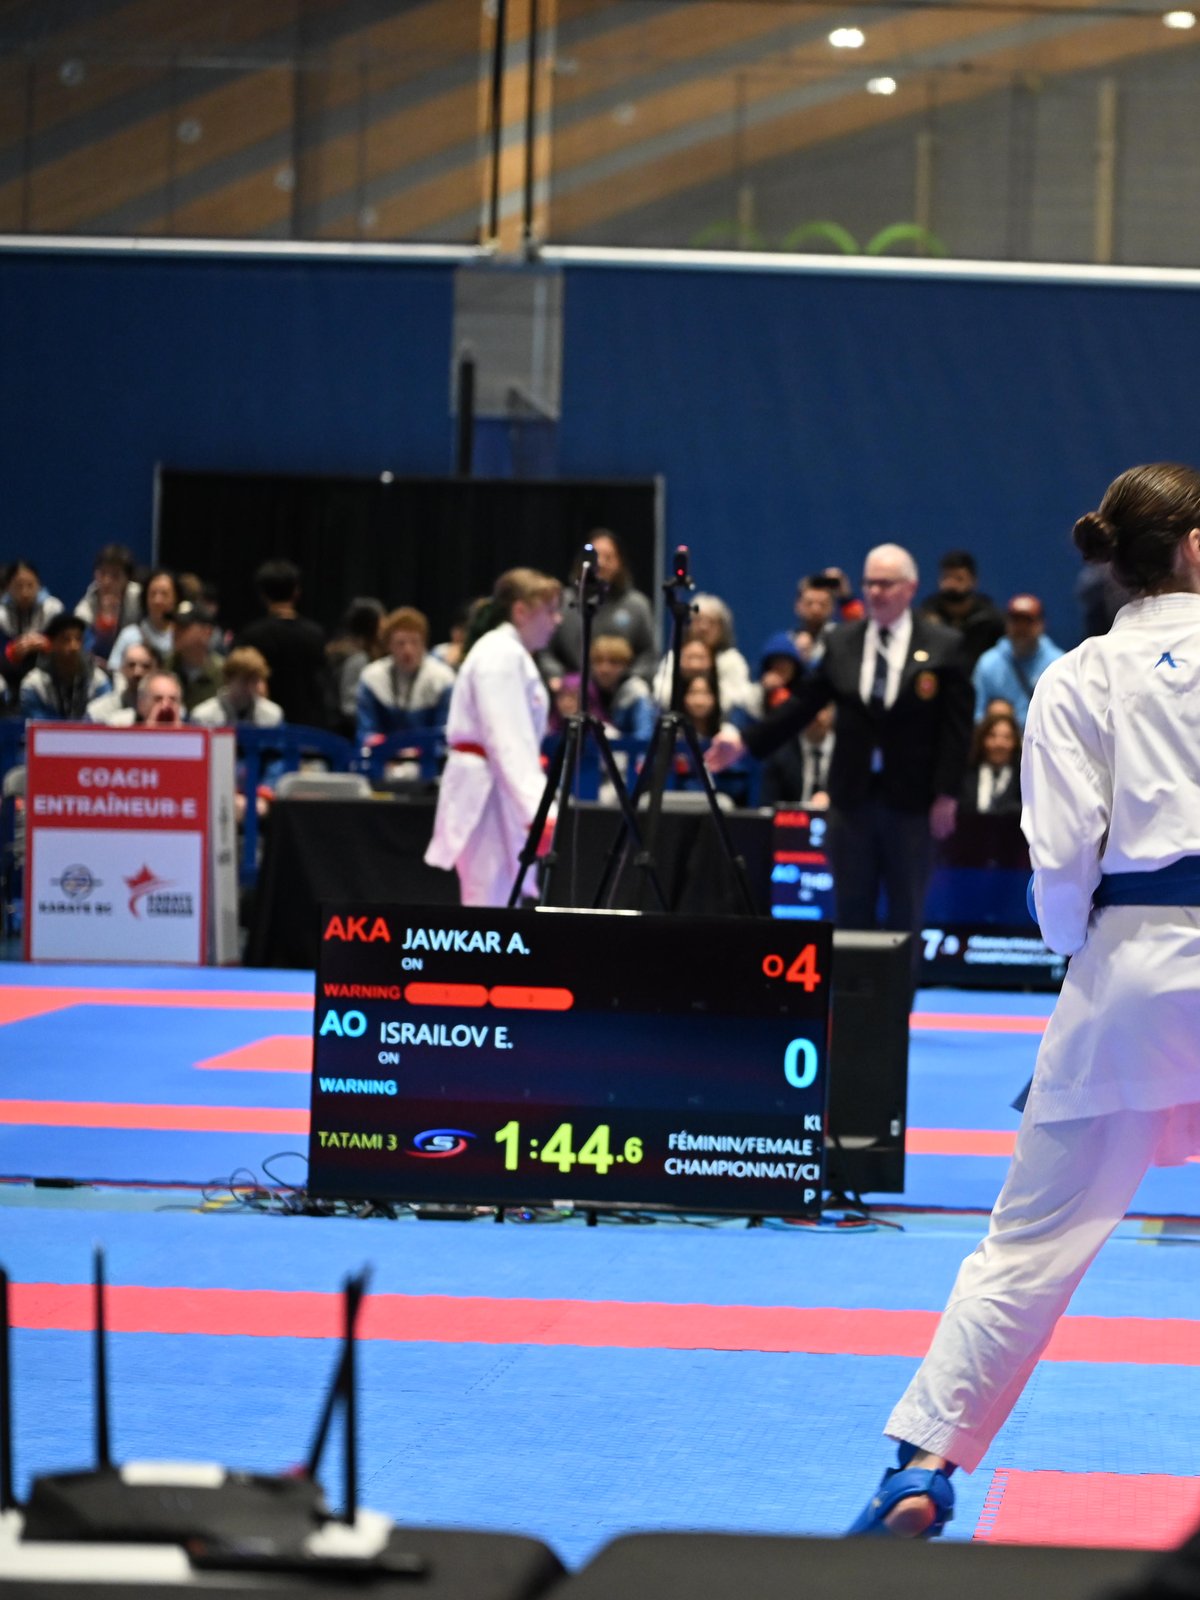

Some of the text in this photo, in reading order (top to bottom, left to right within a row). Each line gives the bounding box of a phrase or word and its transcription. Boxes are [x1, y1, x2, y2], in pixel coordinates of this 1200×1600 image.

[78, 768, 159, 789] COACH
[323, 915, 391, 943] AKA
[401, 928, 530, 955] JAWKAR A.
[401, 957, 423, 971] ON
[323, 983, 400, 1000] WARNING
[319, 1009, 367, 1037] AO
[380, 1021, 514, 1049] ISRAILOV E.
[377, 1051, 399, 1064] ON
[784, 1038, 818, 1088] 0
[319, 1077, 398, 1095] WARNING
[318, 1131, 398, 1151] TATAMI 3
[668, 1129, 813, 1156] FÉMININ/FEMALE
